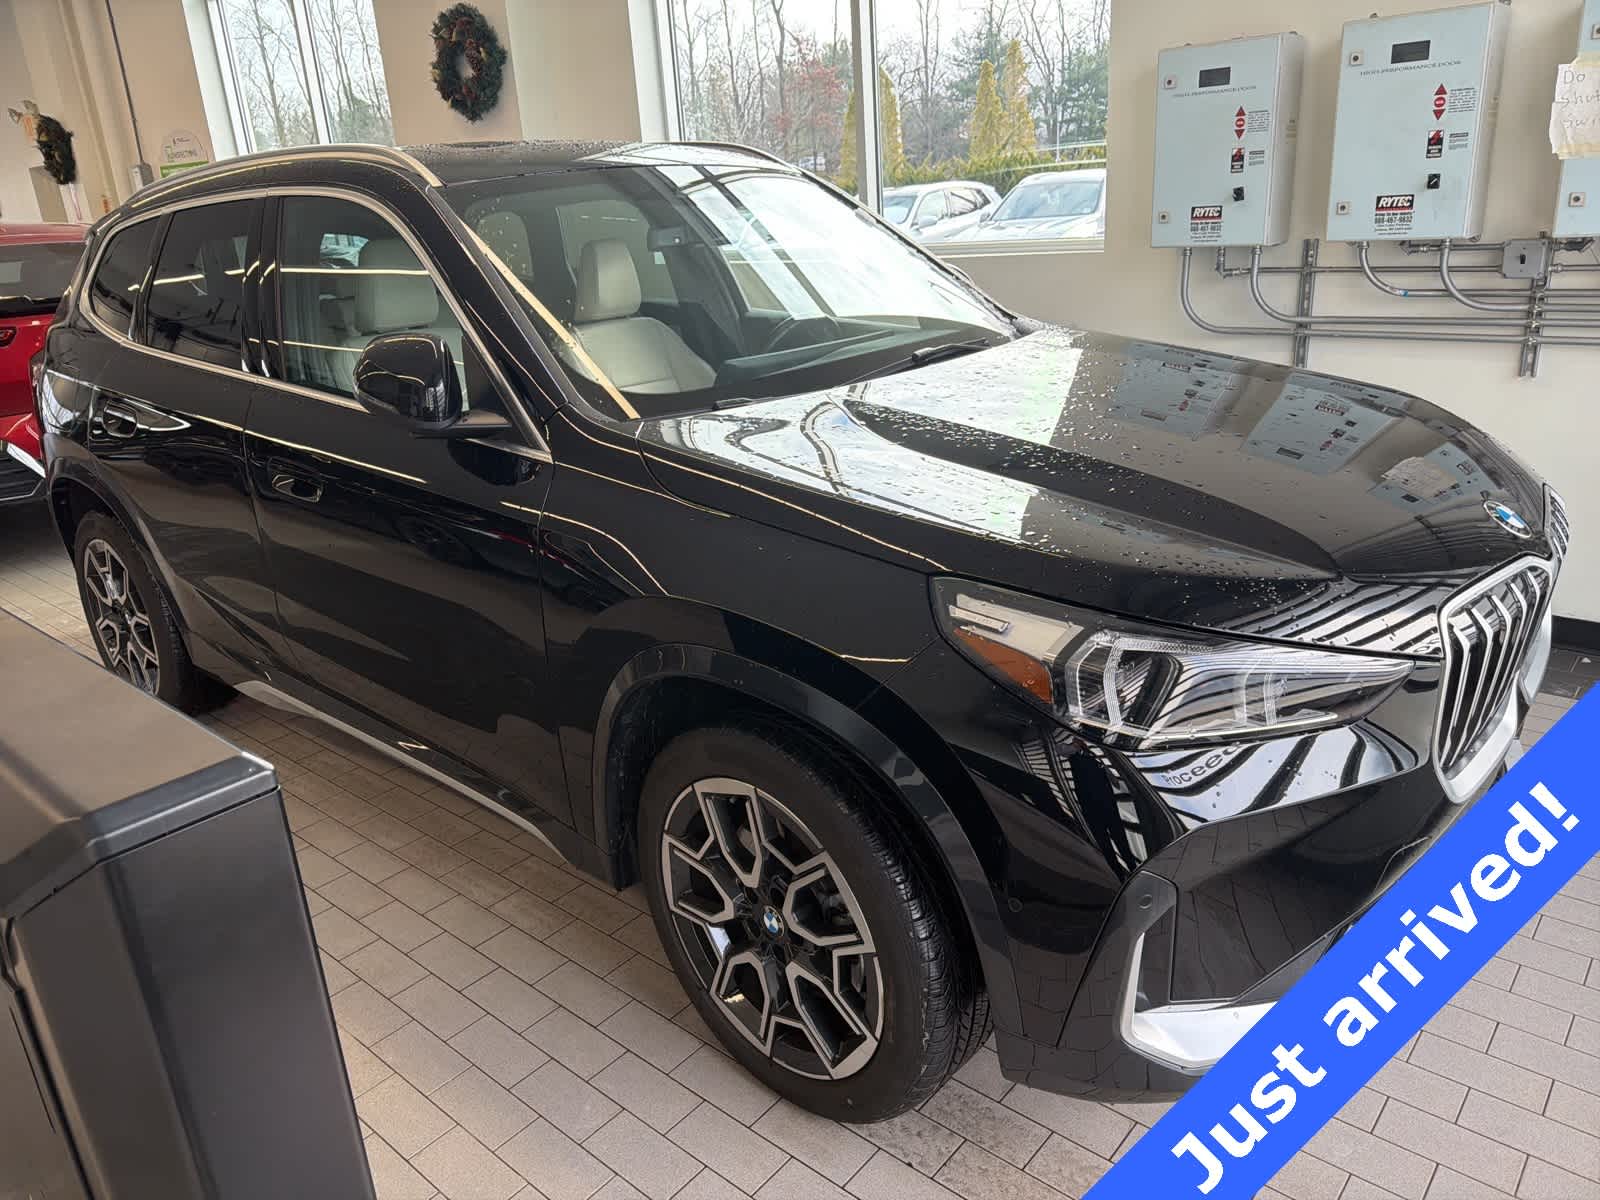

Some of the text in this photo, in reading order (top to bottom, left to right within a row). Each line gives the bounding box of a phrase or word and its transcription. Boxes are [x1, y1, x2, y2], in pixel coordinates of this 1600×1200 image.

[1563, 70, 1586, 84] Do
[1378, 196, 1413, 208] RYTEC
[1192, 207, 1221, 218] RYTEC
